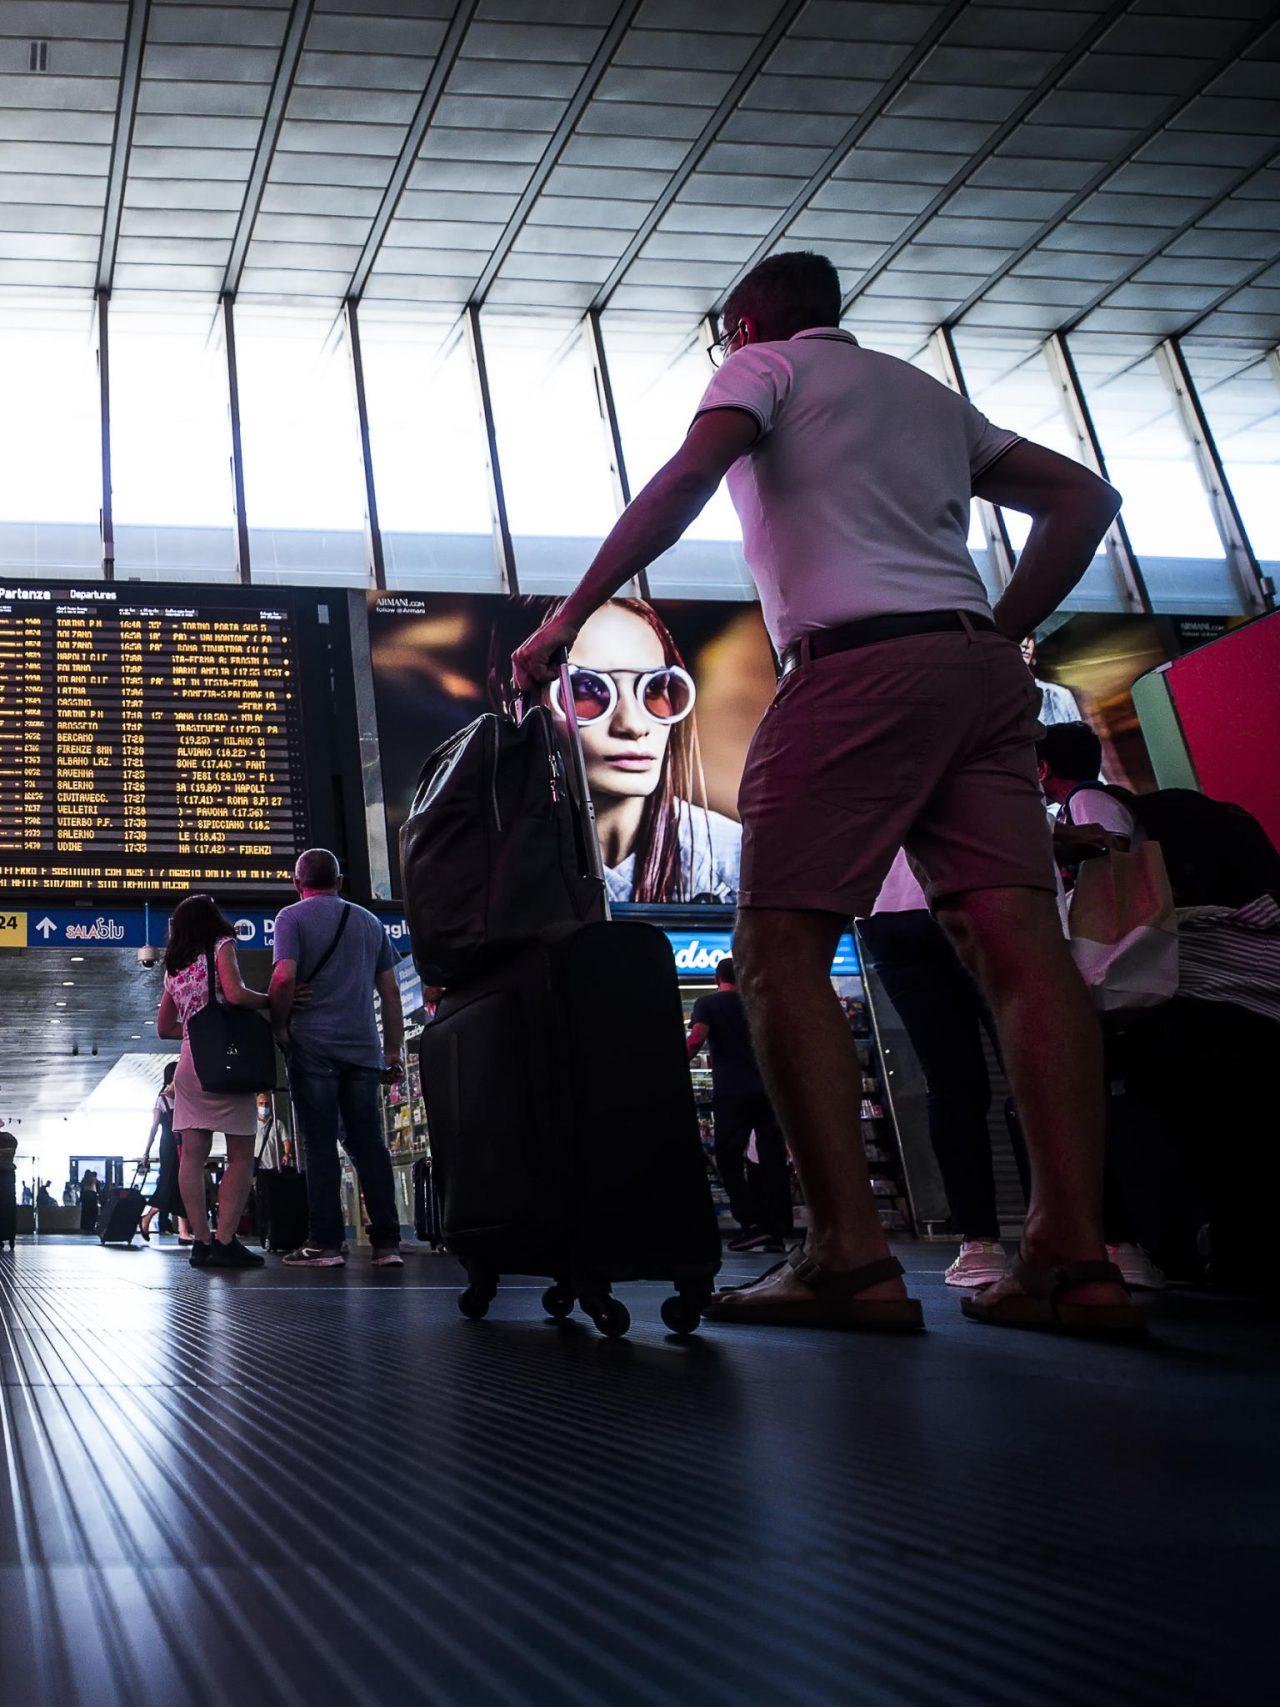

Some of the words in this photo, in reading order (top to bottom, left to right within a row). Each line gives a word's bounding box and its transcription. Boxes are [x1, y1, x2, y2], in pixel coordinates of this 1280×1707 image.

[70, 591, 117, 600] Departures
[58, 745, 91, 753] FIRENZE
[58, 757, 88, 765] ALBANO
[58, 769, 93, 777] RAVENNA
[58, 781, 93, 789] SALERNO
[235, 784, 264, 793] NAPOLI
[58, 793, 108, 802] CIVITAVECC.
[228, 796, 248, 804] ROMA
[58, 806, 97, 814] VELLETRI
[197, 808, 228, 816] PAVONA
[58, 818, 92, 826] VITERBO
[58, 830, 94, 838] SALERNO
[58, 842, 81, 851] UDINE
